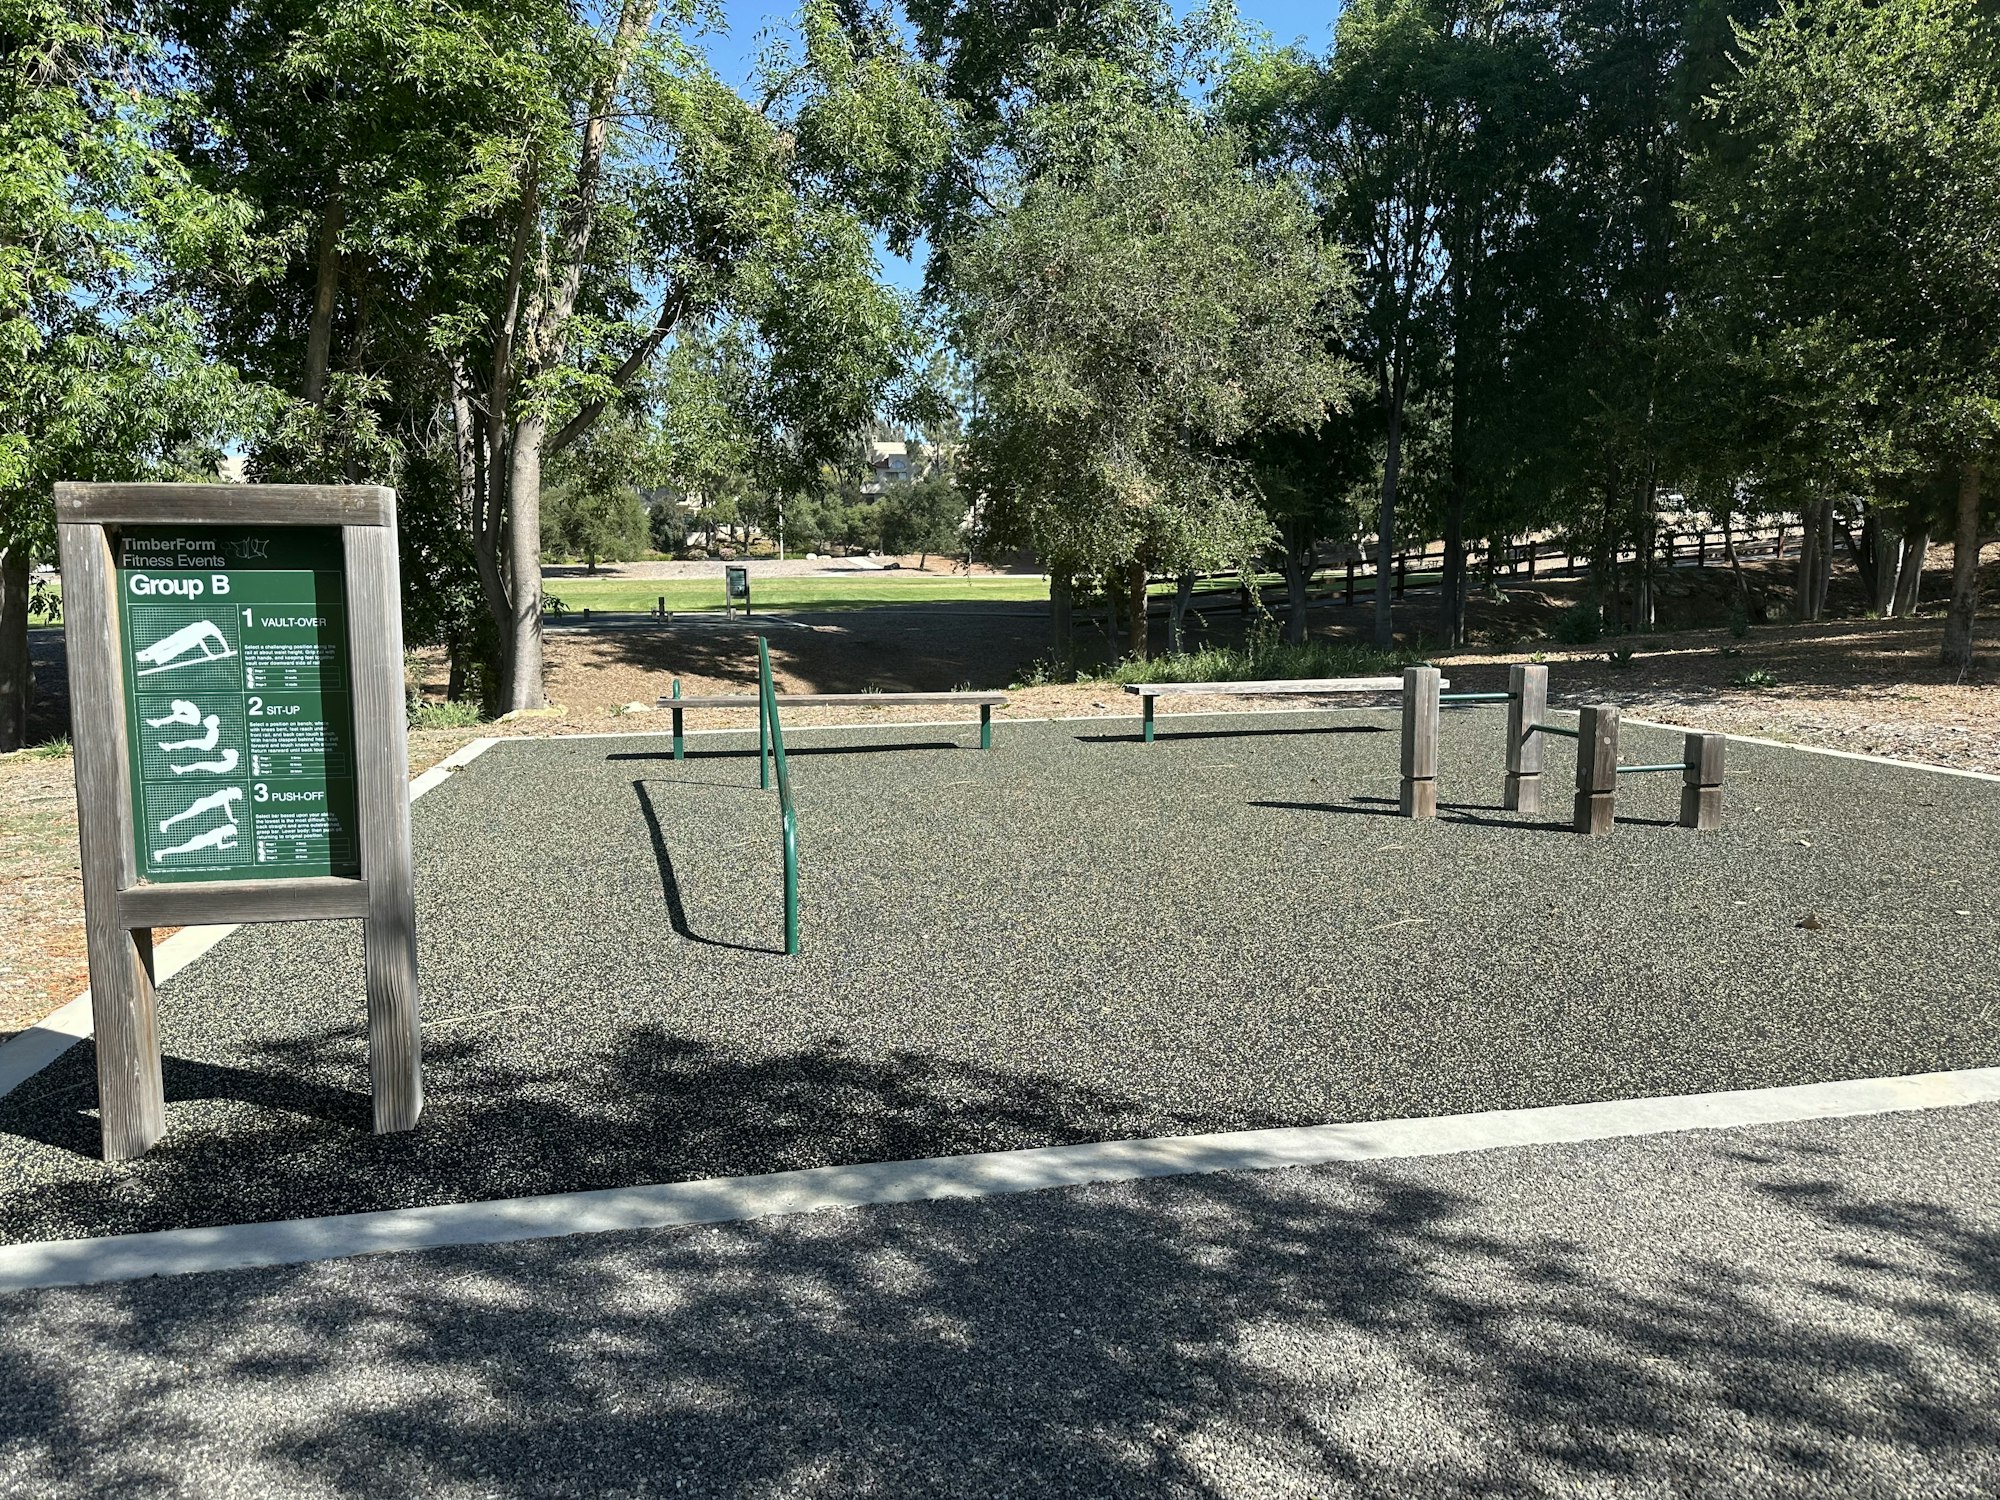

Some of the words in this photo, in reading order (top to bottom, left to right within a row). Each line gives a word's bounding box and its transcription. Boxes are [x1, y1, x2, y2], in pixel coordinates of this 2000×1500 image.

[122, 538, 216, 551] TimberForm
[123, 554, 174, 567] Fitness
[178, 554, 226, 567] Events
[130, 574, 204, 600] Group
[211, 574, 230, 595] B
[242, 608, 253, 627] 1
[261, 618, 327, 627] VAULT-OVER
[248, 696, 263, 715] 2
[266, 706, 300, 715] SIT-UP
[254, 783, 269, 802] 3
[272, 792, 324, 801] PUSH-OFF
